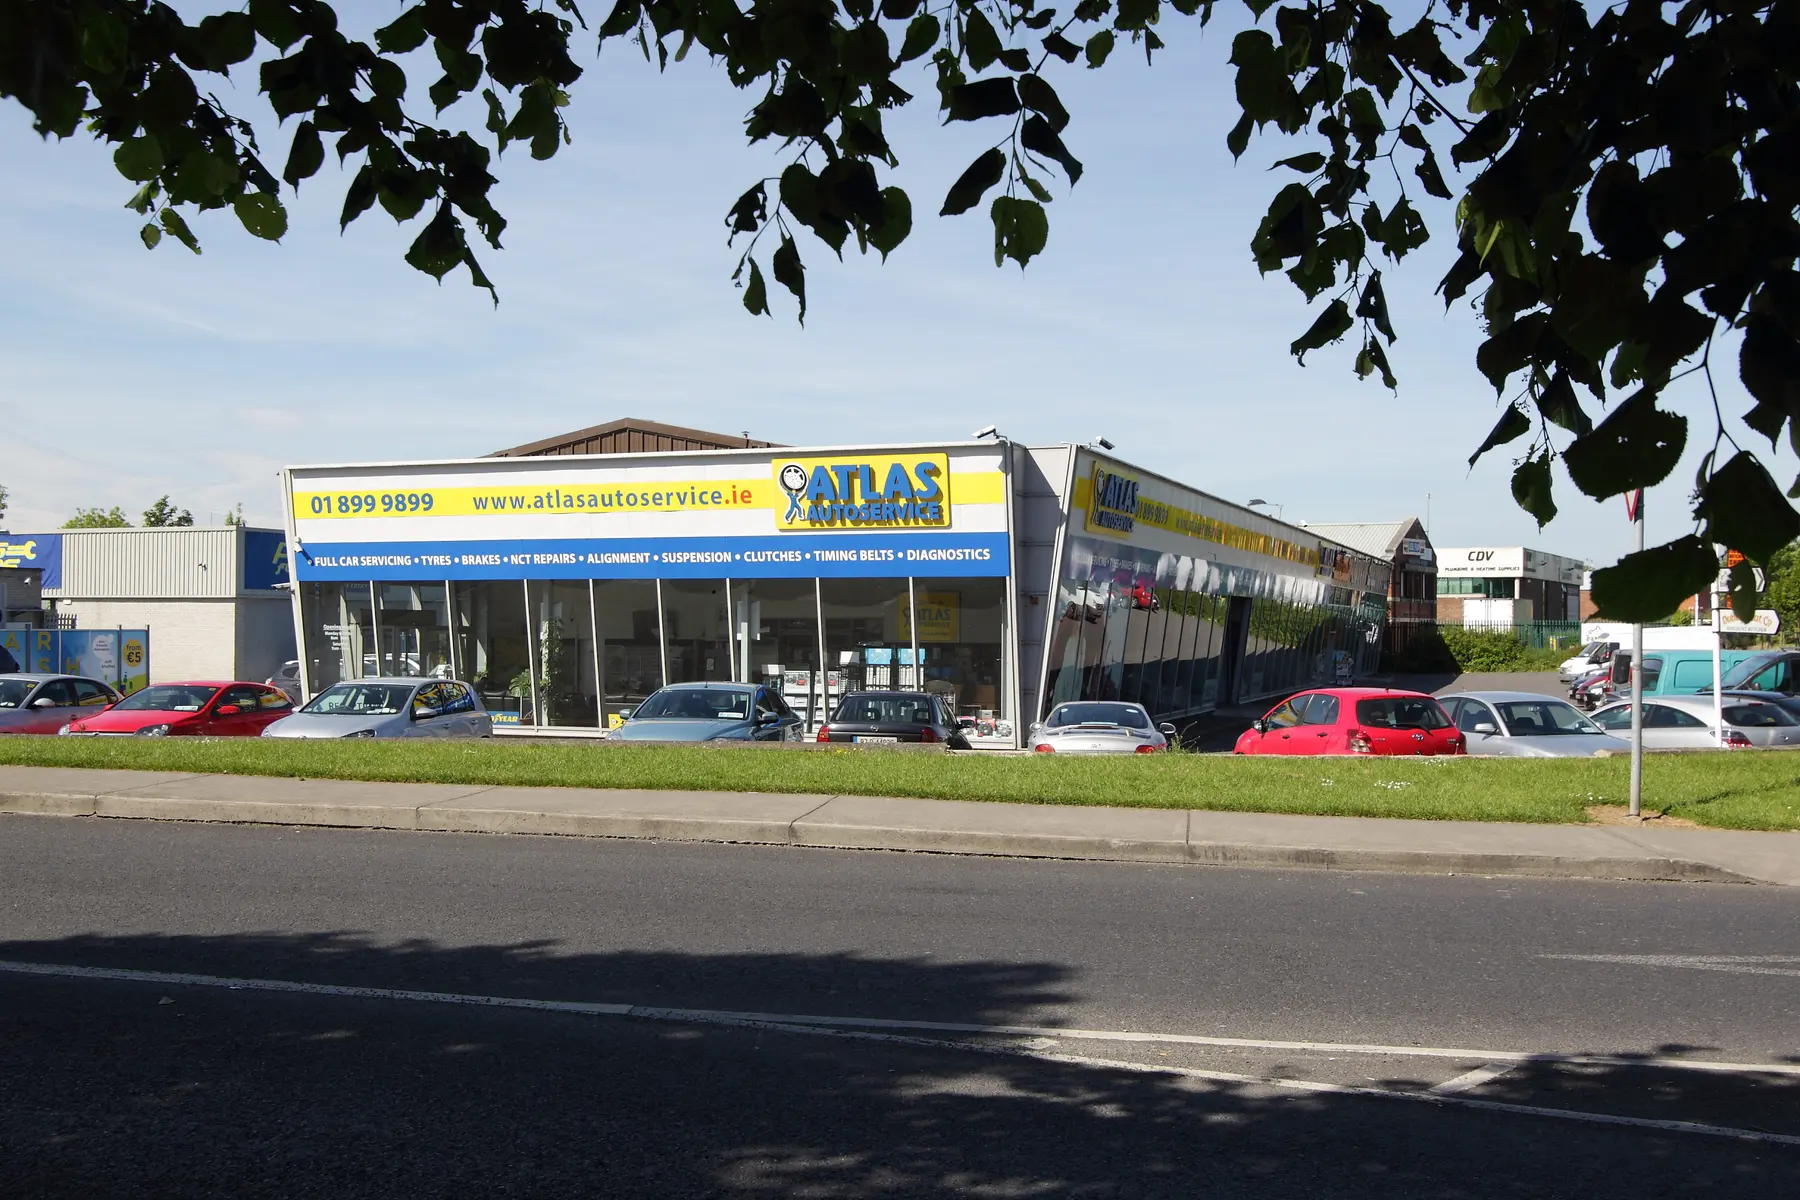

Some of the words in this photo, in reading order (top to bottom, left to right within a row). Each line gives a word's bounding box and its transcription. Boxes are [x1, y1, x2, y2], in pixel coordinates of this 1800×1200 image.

[806, 461, 940, 501] ATLAS
[310, 495, 332, 515] 01
[337, 494, 377, 514] 899
[380, 492, 434, 513] 9899
[472, 484, 752, 511] www.atlasautoservice.ie
[1104, 474, 1139, 514] ATLAS
[806, 501, 941, 521] AUTOSERVICE
[1143, 502, 1155, 522] 899
[314, 556, 339, 567] FULL
[340, 556, 360, 567] CAR
[360, 555, 412, 566] SERVICING
[420, 554, 452, 566] TYRES
[461, 554, 501, 566] BRAKES
[510, 553, 532, 565] NCT
[533, 553, 577, 565] REPAIRS
[587, 552, 651, 564] ALIGNMENT
[661, 551, 732, 563] SUSPENSION
[743, 551, 802, 563] CLUTCHES
[813, 549, 858, 562] TIMING
[859, 549, 895, 561] BELTS
[906, 548, 991, 561] DIAGNOSTICS
[1468, 550, 1495, 562] CDV
[126, 652, 141, 663] €5
